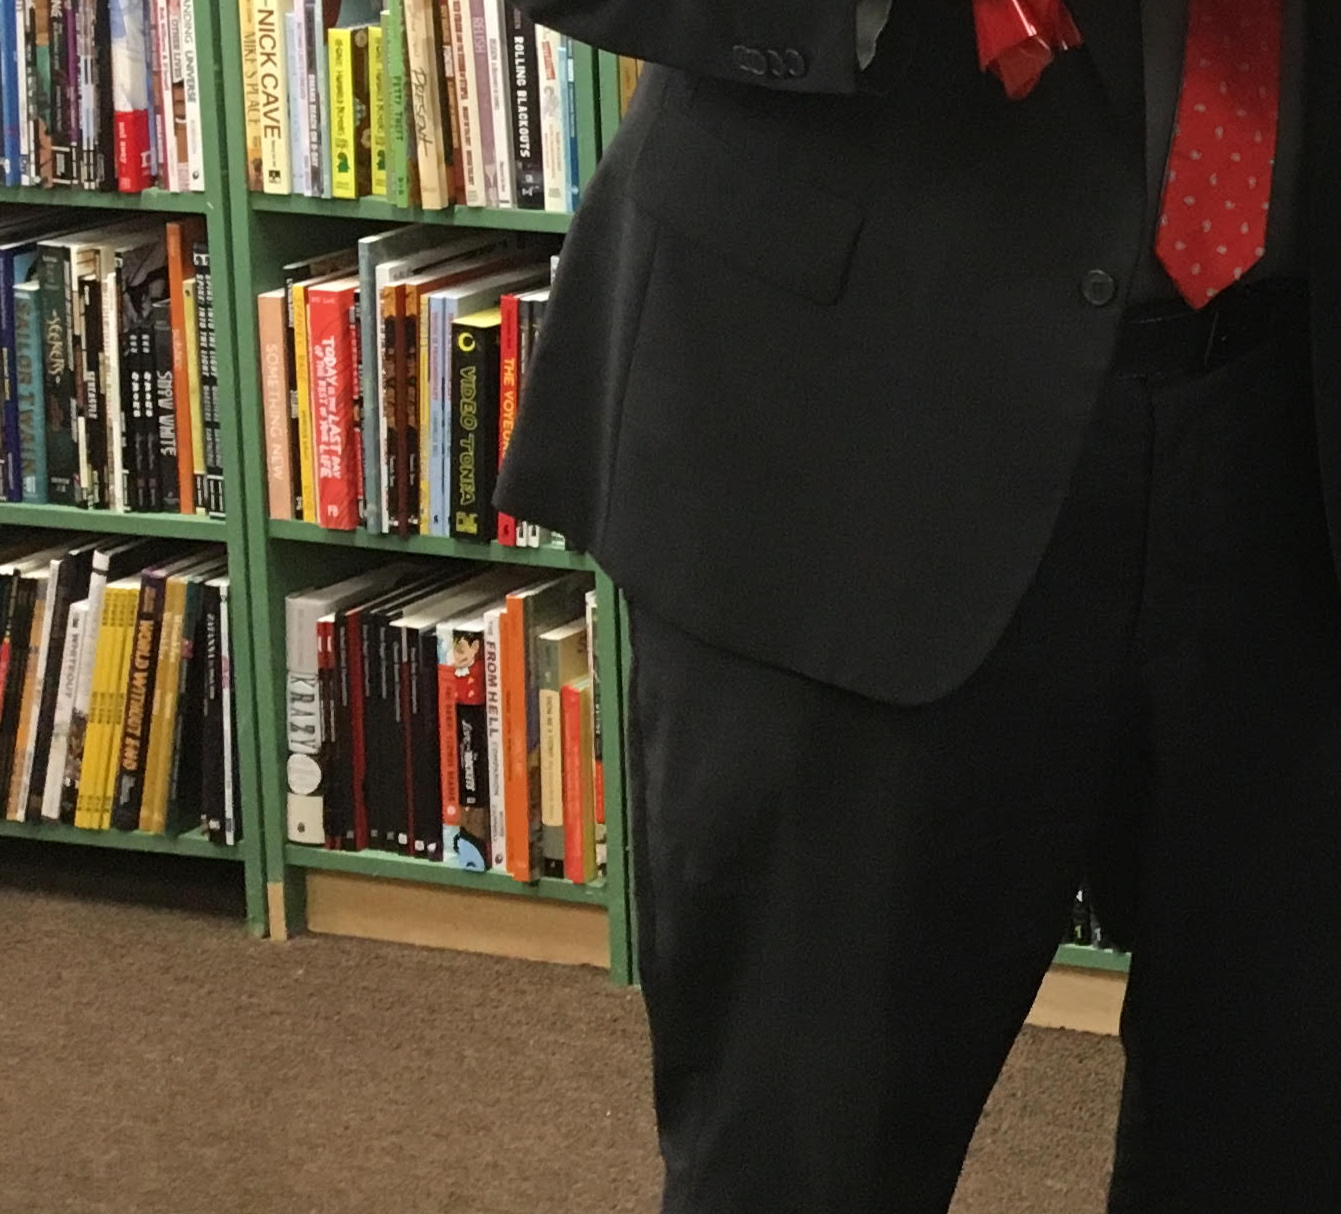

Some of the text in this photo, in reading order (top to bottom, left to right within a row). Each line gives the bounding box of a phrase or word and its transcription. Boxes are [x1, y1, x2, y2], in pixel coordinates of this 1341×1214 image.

[185, 49, 198, 104] UNIVERSE
[256, 9, 282, 140] NICK CAVE
[514, 36, 532, 159] ROLLING BLACKOUTS
[321, 335, 338, 386] TODAY
[504, 358, 515, 387] THE
[266, 343, 285, 481] SOMETHING NEW
[459, 366, 477, 431] VIDEO
[486, 639, 499, 687] FROM
[289, 674, 317, 755] KRAZY
[488, 690, 500, 738] HELL
